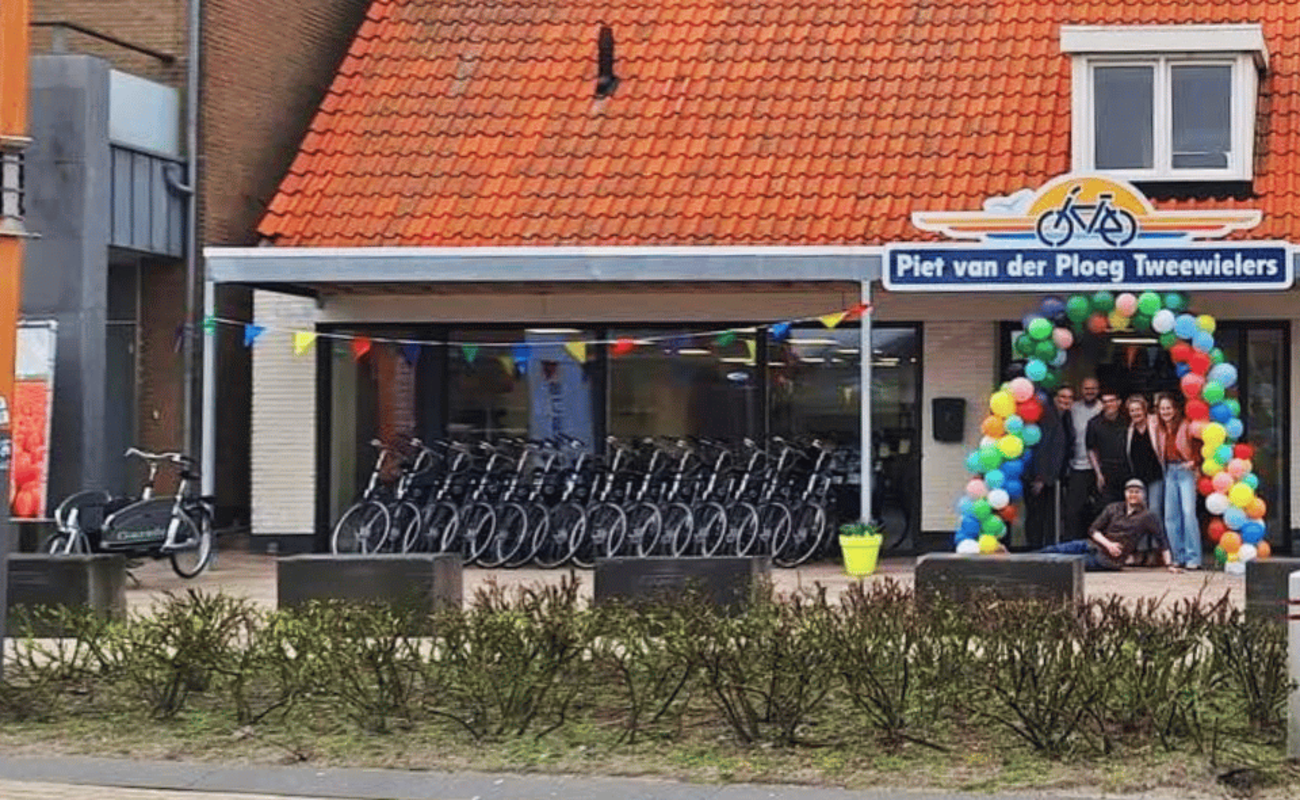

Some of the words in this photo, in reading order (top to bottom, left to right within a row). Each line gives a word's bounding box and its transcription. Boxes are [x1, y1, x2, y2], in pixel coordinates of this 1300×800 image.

[897, 253, 944, 277] Piet
[952, 260, 998, 277] van
[1007, 253, 1047, 277] der
[1056, 253, 1125, 283] Ploeg
[1133, 252, 1278, 276] Tweewielers
